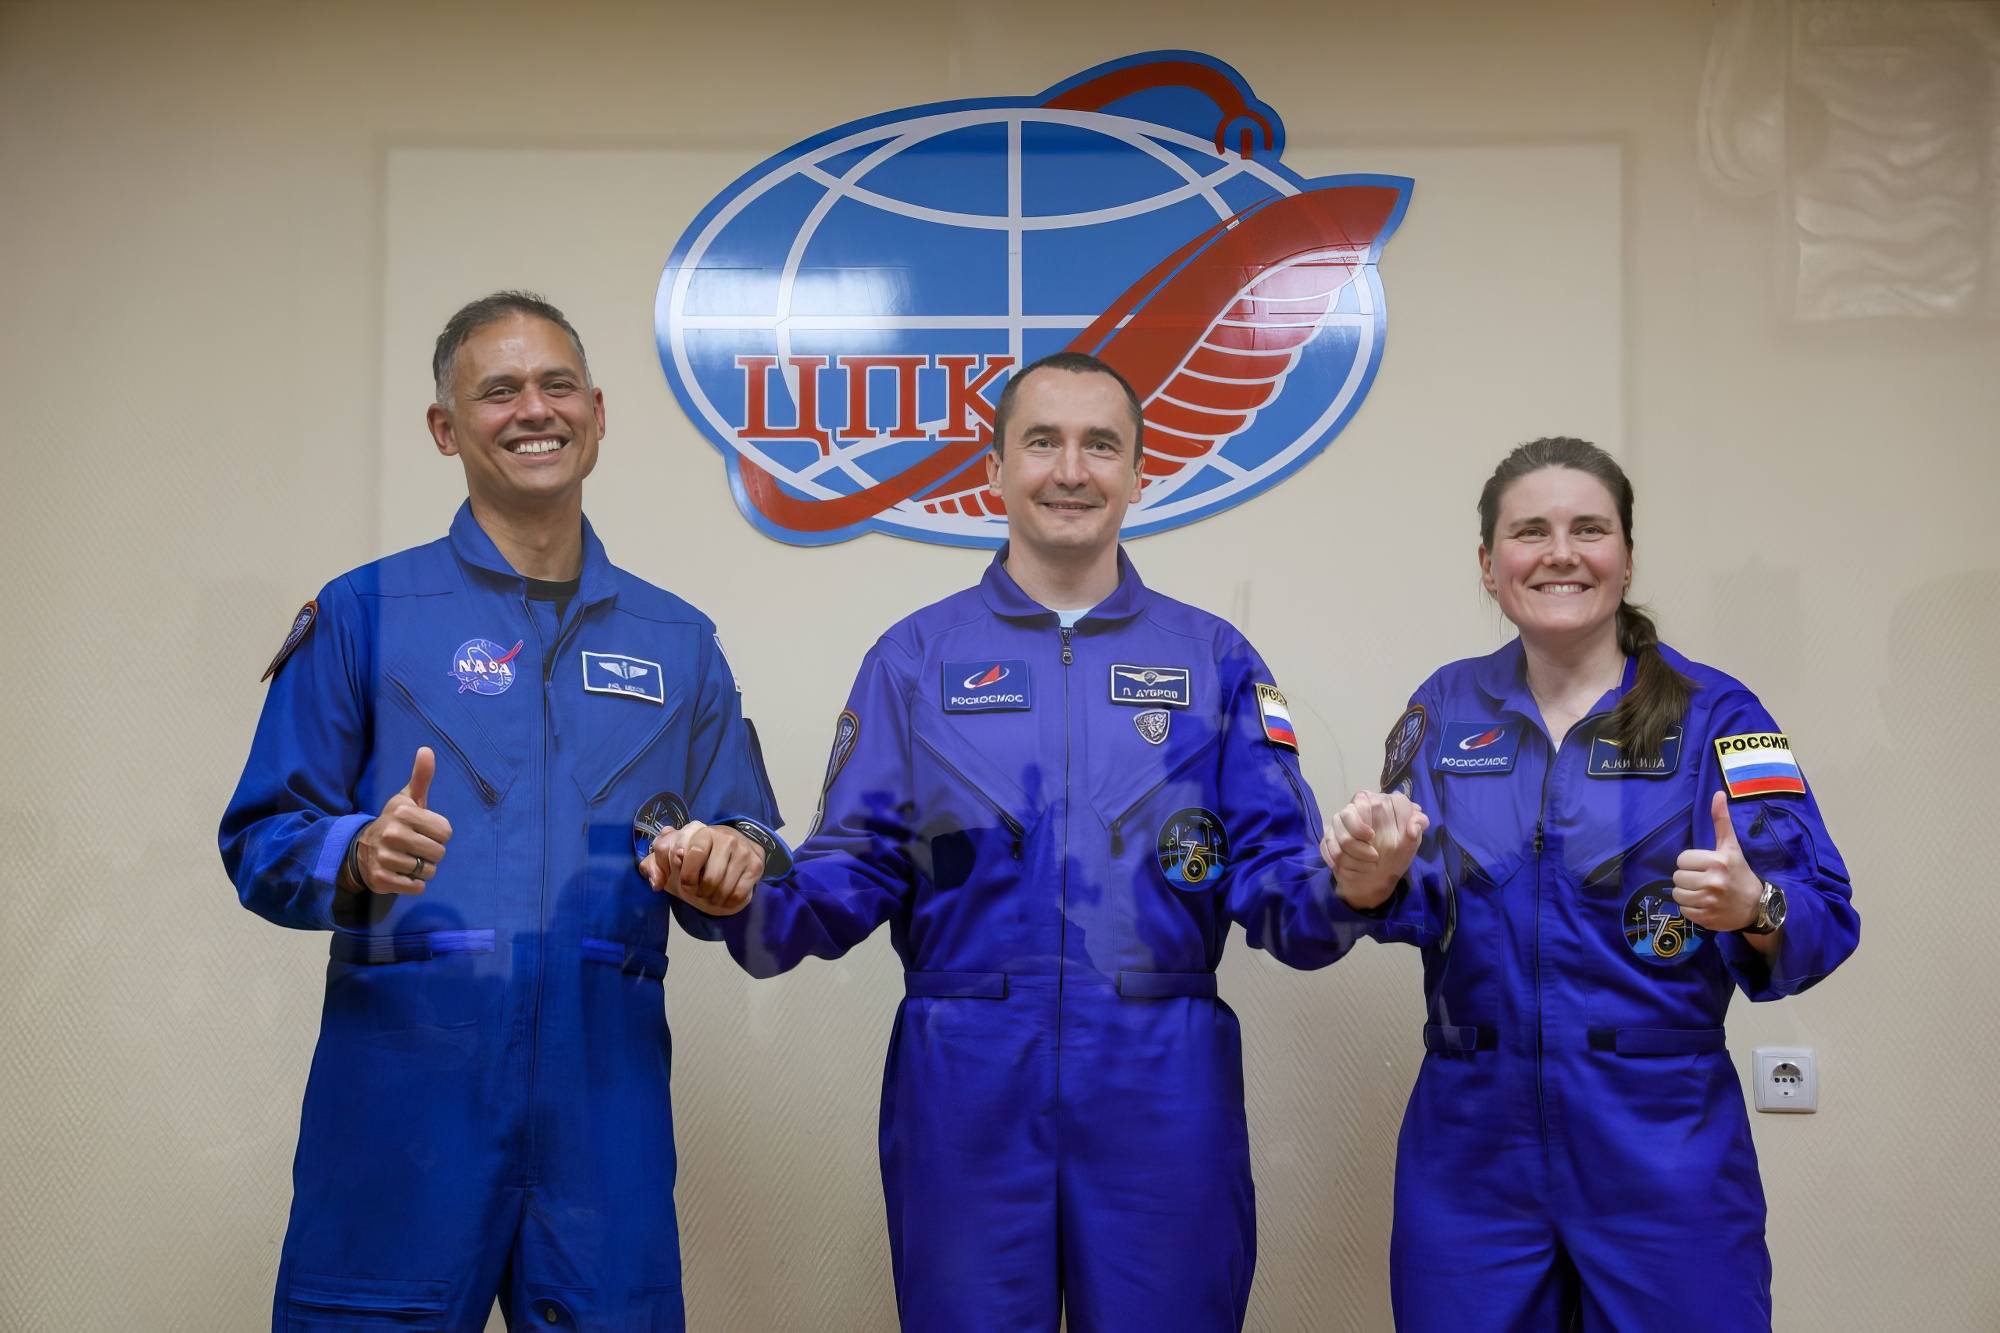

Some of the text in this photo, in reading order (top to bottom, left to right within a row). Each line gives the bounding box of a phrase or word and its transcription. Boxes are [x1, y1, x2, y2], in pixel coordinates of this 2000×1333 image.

[735, 355, 1015, 456] ЦПК
[459, 660, 512, 676] NASA
[951, 694, 1024, 705] РОСКОСМОС
[1719, 735, 1789, 755] РОССИЯ
[1180, 840, 1209, 883] 75
[1649, 914, 1684, 957] 75
